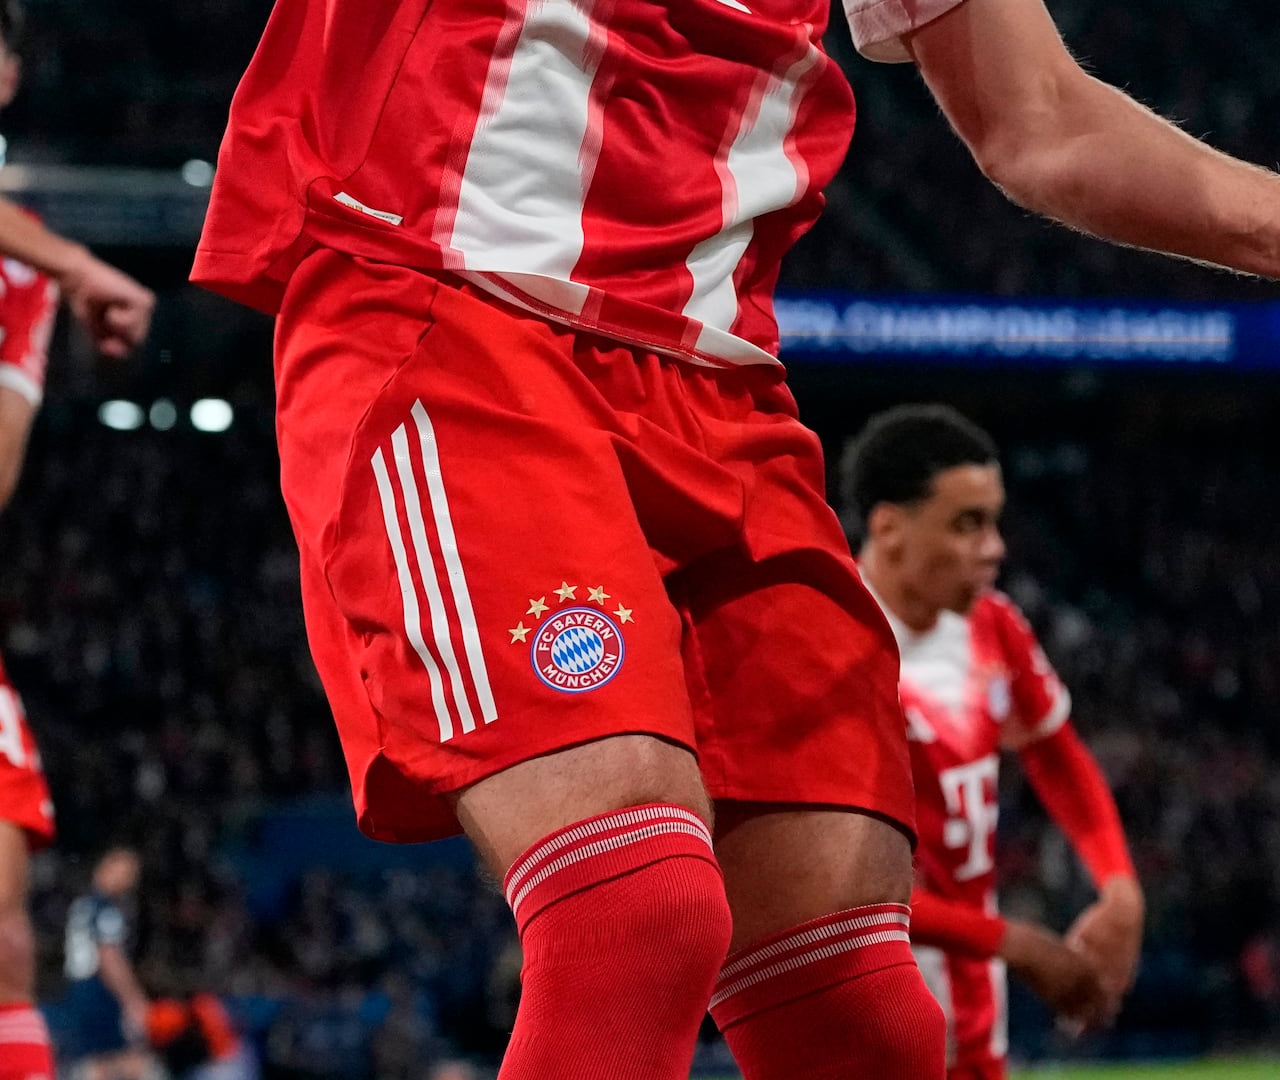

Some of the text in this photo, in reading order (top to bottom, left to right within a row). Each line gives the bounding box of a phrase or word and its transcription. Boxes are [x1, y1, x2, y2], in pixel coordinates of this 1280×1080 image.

[538, 613, 614, 651] FC BAYERN
[542, 652, 618, 687] MÜNCHEN
